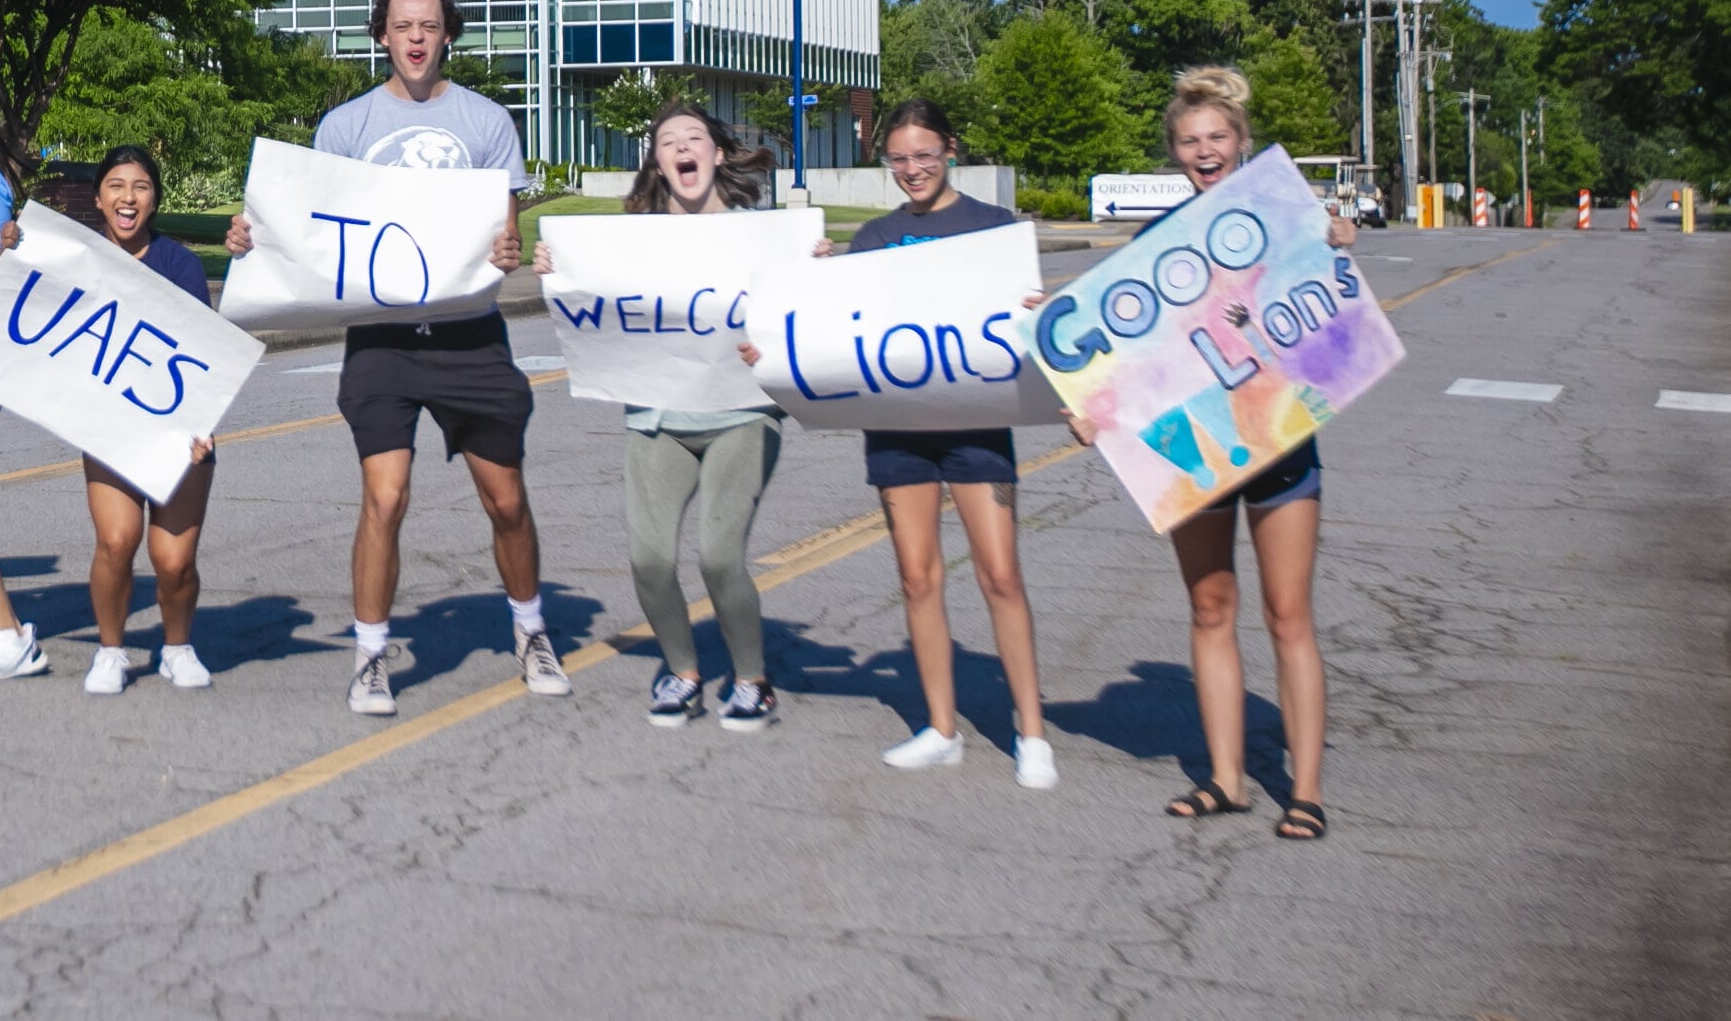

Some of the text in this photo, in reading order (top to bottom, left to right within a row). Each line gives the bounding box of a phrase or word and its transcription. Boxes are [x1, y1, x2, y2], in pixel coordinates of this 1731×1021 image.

[1098, 182, 1192, 195] ORIENTATION
[310, 211, 430, 308] TO
[7, 269, 210, 416] UAFS
[785, 310, 1022, 402] Lions
